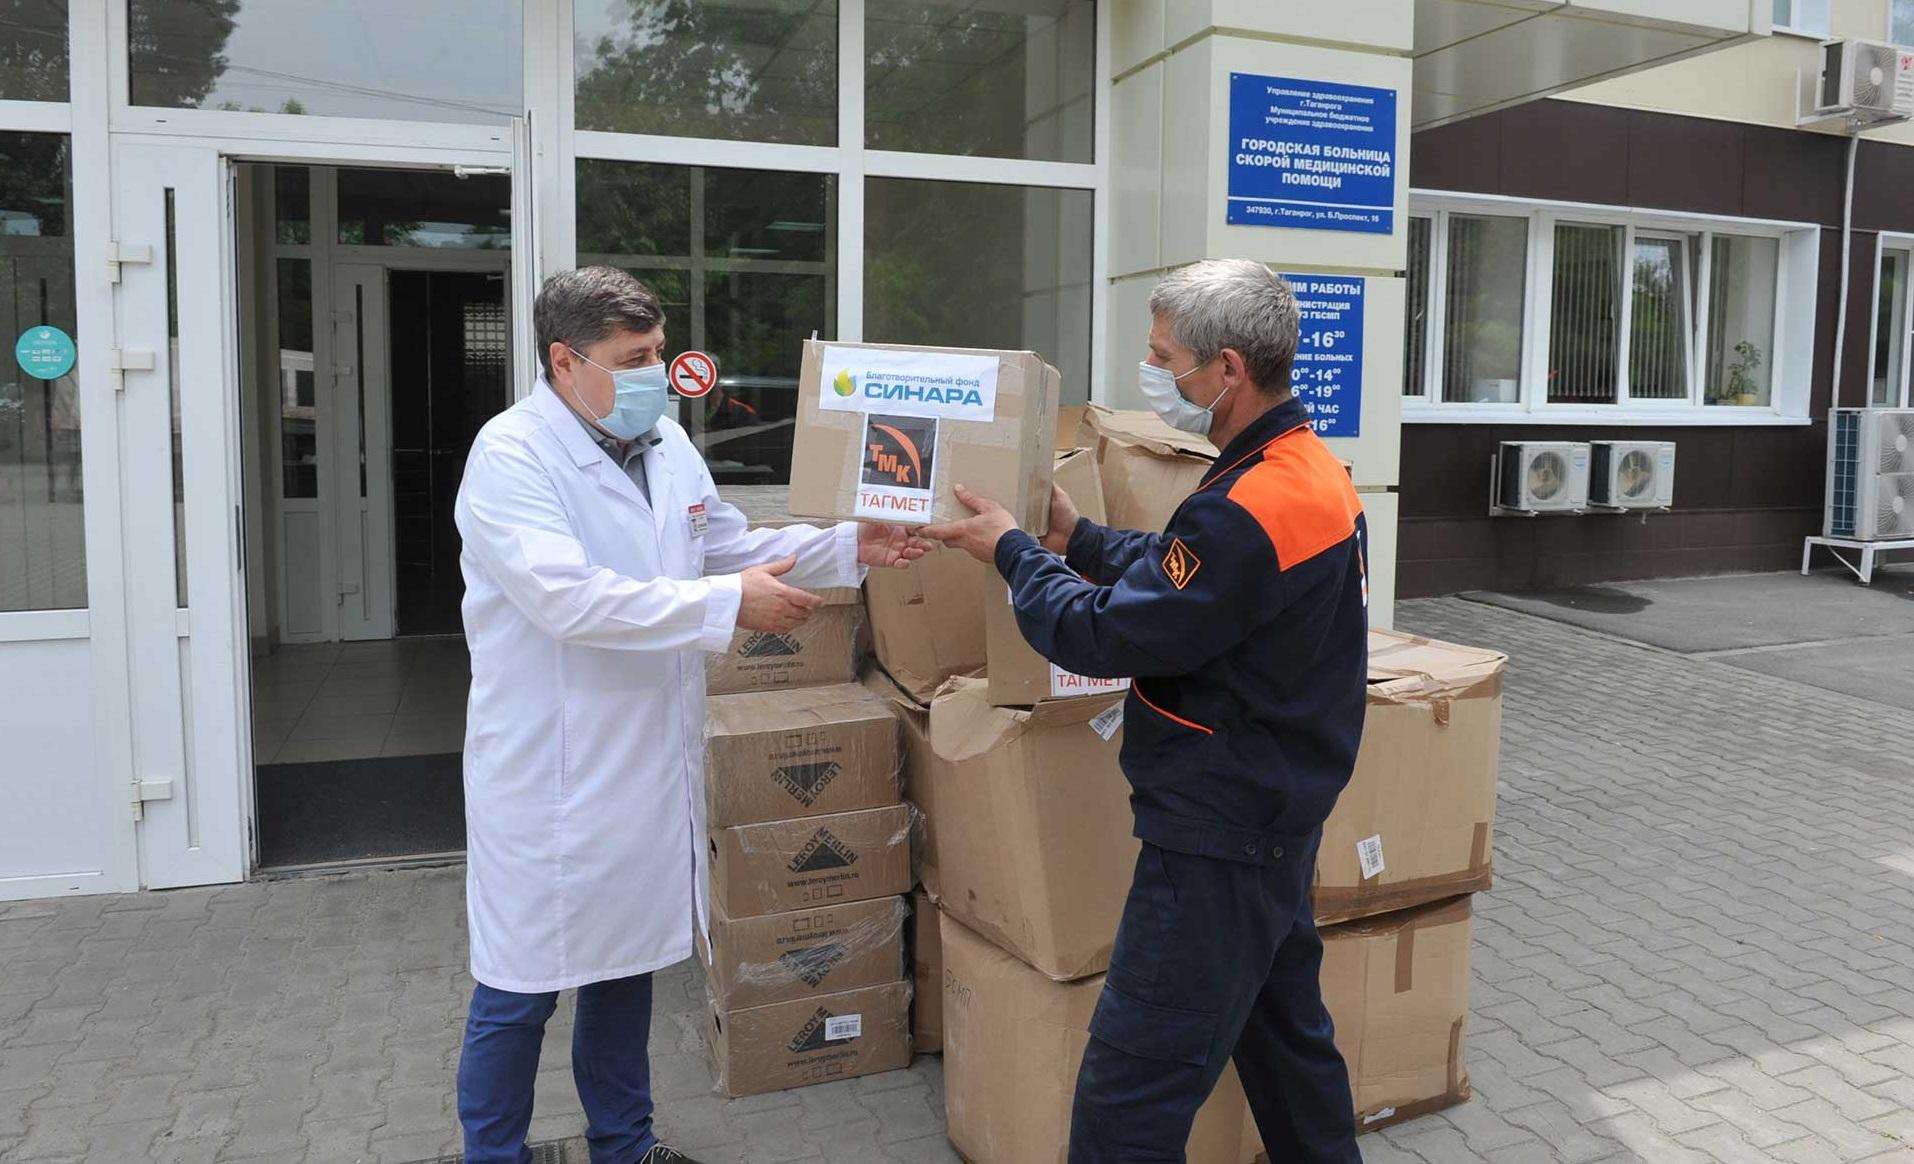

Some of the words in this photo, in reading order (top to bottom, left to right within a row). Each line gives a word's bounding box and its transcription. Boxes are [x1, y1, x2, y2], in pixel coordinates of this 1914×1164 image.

[1266, 86, 1311, 98] Управление
[1312, 92, 1374, 104] здравоохранения
[1300, 99, 1342, 110] г.Таганрога
[1270, 106, 1328, 118] Муниципальное
[1329, 111, 1370, 122] бюджетное
[1265, 116, 1310, 126] учреждение
[1312, 120, 1374, 132] здравоохранения
[1241, 138, 1320, 156] ГОРОДСКАЯ
[1324, 146, 1391, 163] БОЛЬНИЦА
[1236, 154, 1291, 168] СКОРОЙ
[1294, 159, 1390, 177] МЕДИЦИНСКОЙ
[1282, 172, 1341, 189] ПОМОЩИ
[1311, 283, 1360, 295] РАБОТЫ
[1296, 301, 1350, 311] НИСТРАЦИЯ
[1311, 312, 1340, 320] ГБСМП
[1314, 354, 1353, 362] БОЛЬНЫХ
[866, 370, 953, 385] Благотворительный
[955, 376, 980, 388] фонд
[864, 383, 983, 406] СИНАРА
[1318, 405, 1340, 413] ЧАС
[870, 444, 910, 483] ТМК
[860, 493, 929, 512] ТАГМЕТ
[737, 631, 764, 656] LERO
[770, 769, 813, 808] MERLIN
[811, 762, 842, 799] LEROY
[787, 835, 820, 872] LEROY
[816, 826, 858, 864] MERLIN
[787, 1017, 819, 1052] LEROY
